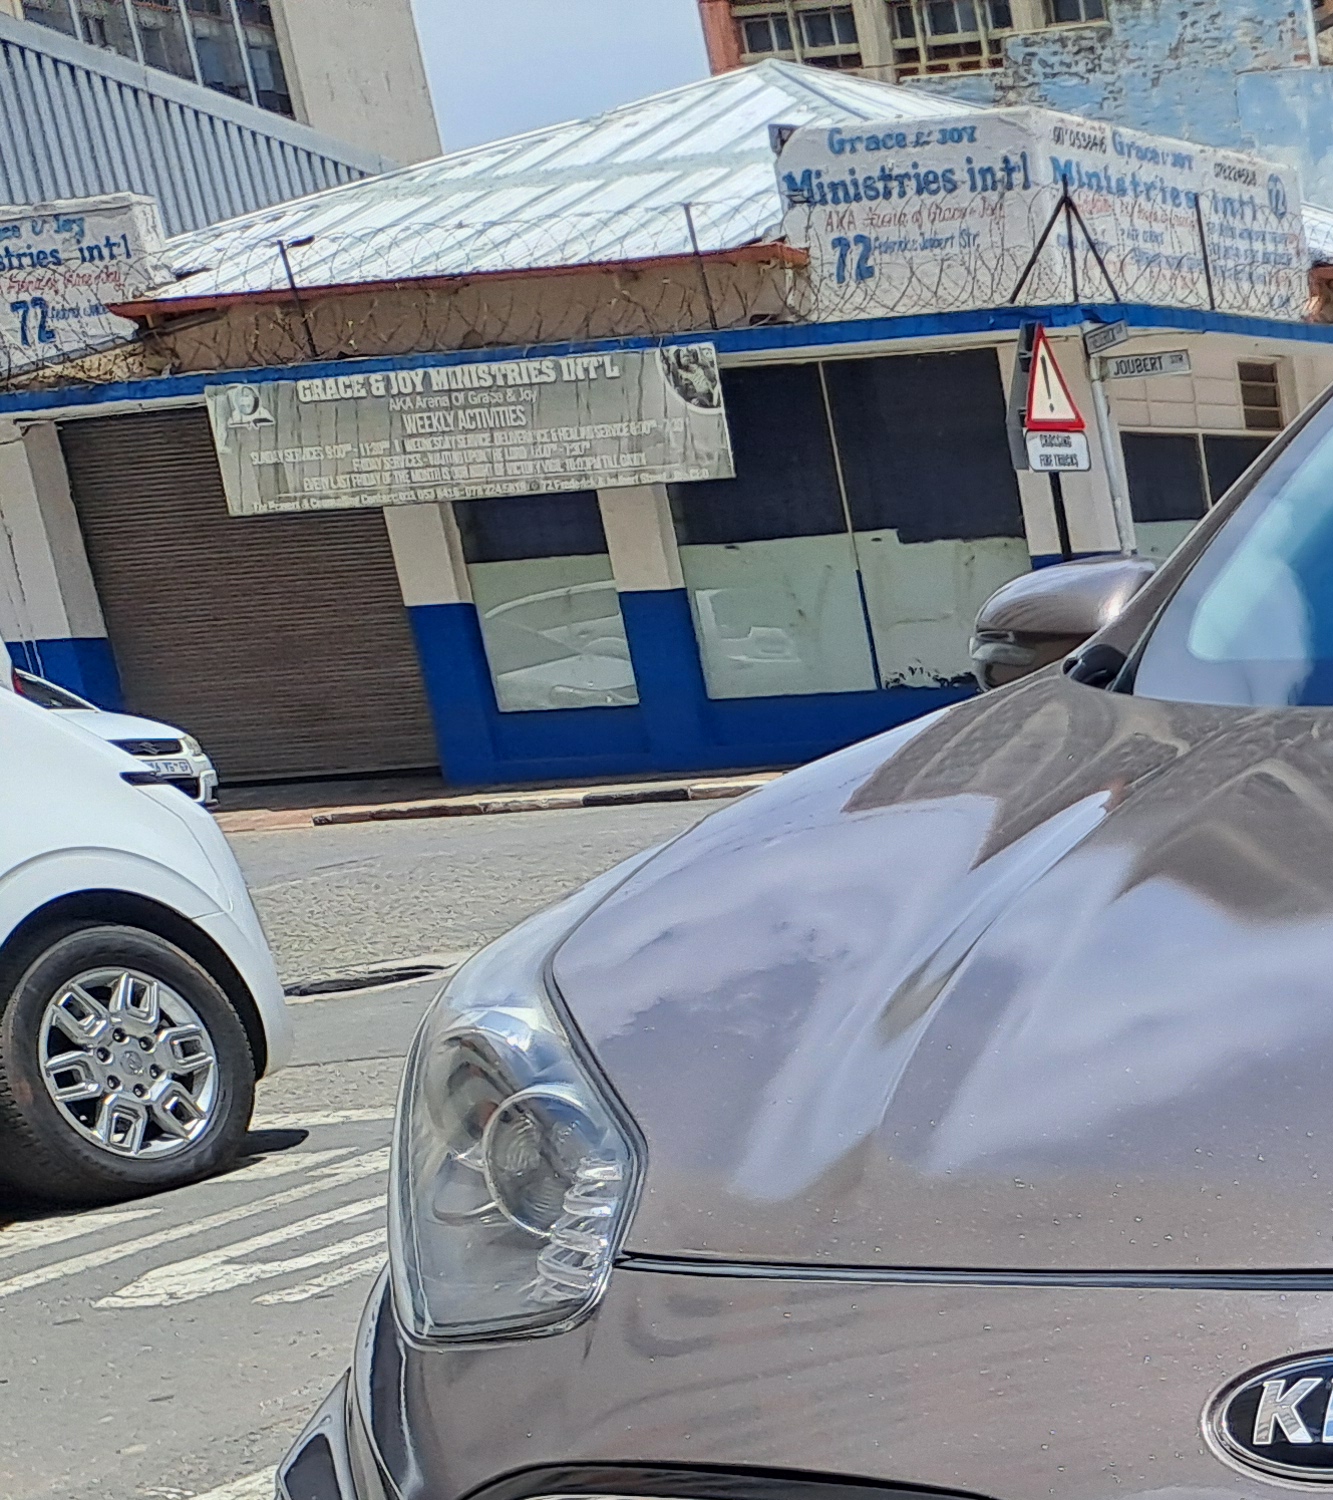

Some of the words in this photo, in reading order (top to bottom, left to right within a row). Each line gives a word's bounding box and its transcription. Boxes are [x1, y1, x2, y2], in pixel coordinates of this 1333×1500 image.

[828, 127, 907, 155] Grace
[782, 160, 958, 207] Ministries
[1050, 156, 1199, 210] Ministries
[831, 234, 875, 285] 72
[10, 296, 57, 347] 72
[297, 375, 368, 403] GRACE
[370, 373, 387, 398] &
[388, 369, 427, 396] JOY
[431, 360, 557, 391] MINISTRIES
[1113, 355, 1164, 376] JOUBERT
[389, 398, 413, 411] AKA
[415, 394, 450, 409] Arena
[518, 389, 538, 404] Joy
[402, 410, 455, 435] WEEKLY
[458, 406, 527, 431] ACTIVITIES
